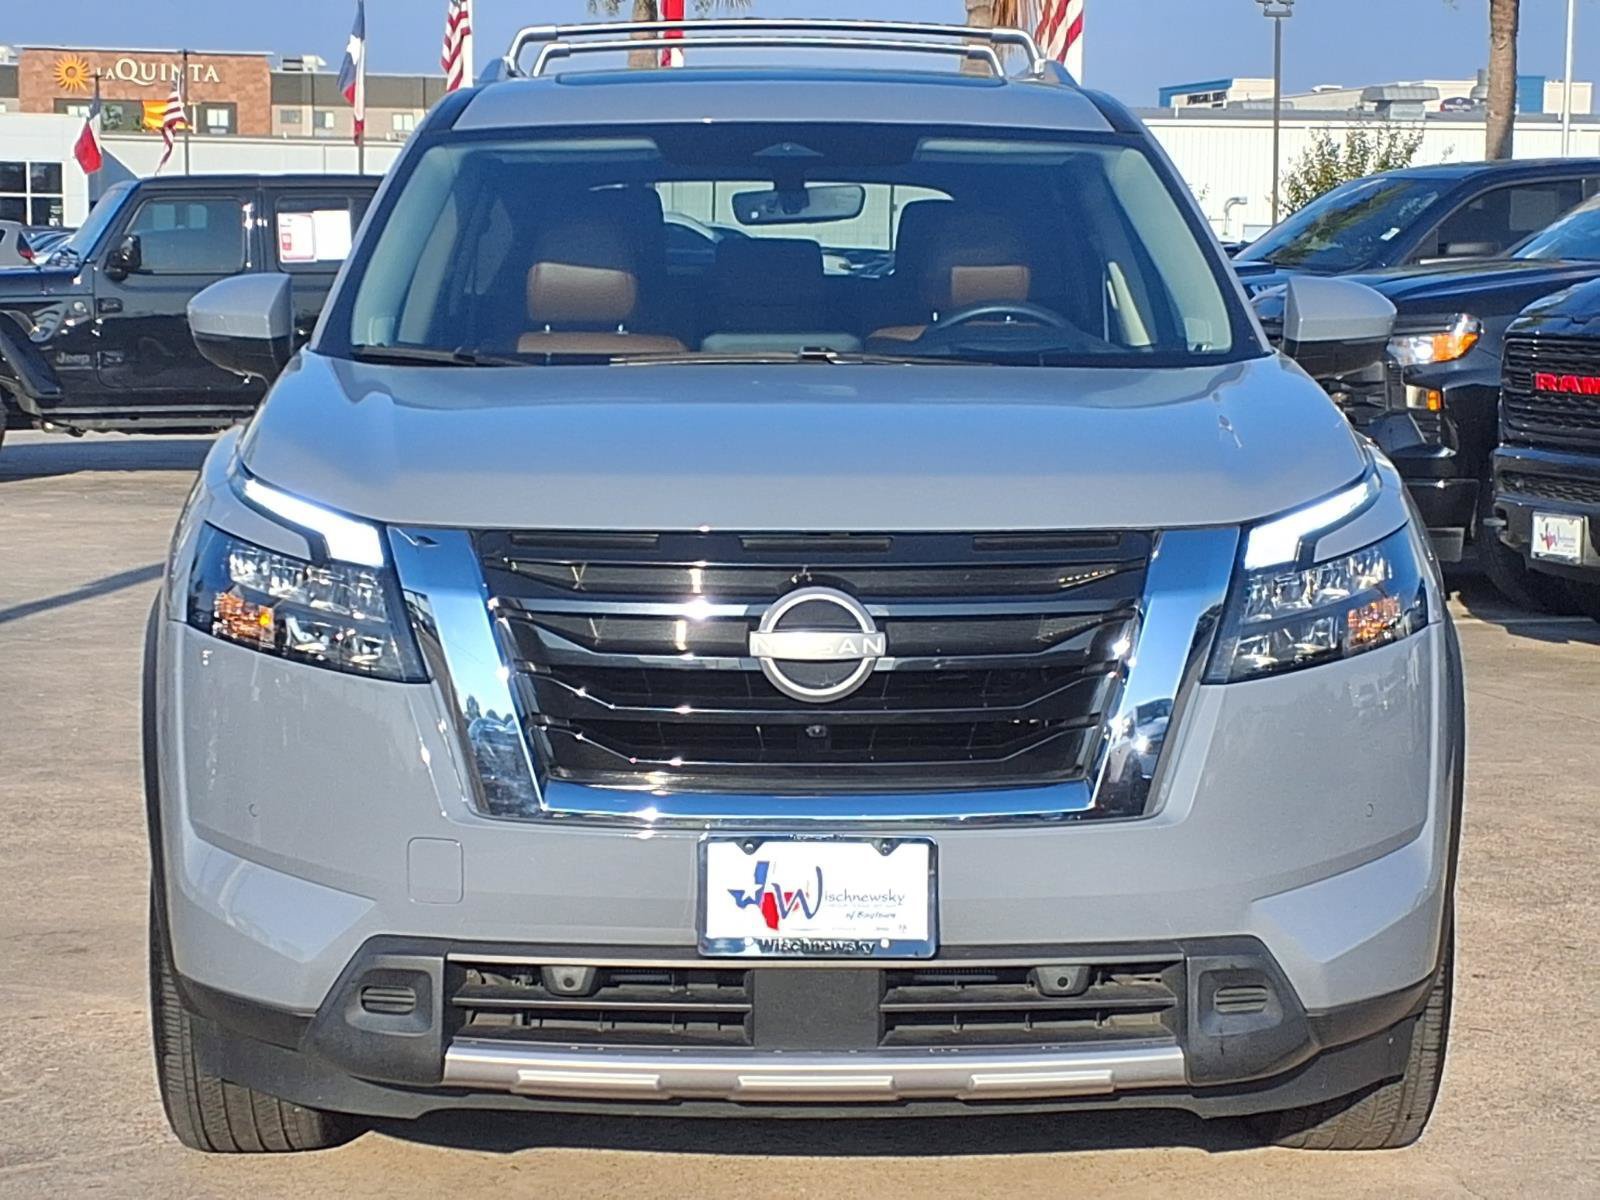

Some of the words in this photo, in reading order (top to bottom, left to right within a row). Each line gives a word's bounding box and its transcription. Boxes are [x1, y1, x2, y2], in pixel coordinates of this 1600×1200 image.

[115, 58, 220, 86] QUINTA
[1535, 372, 1600, 395] RAM
[753, 637, 882, 655] NSAN
[760, 938, 876, 955] Wischnewsky
